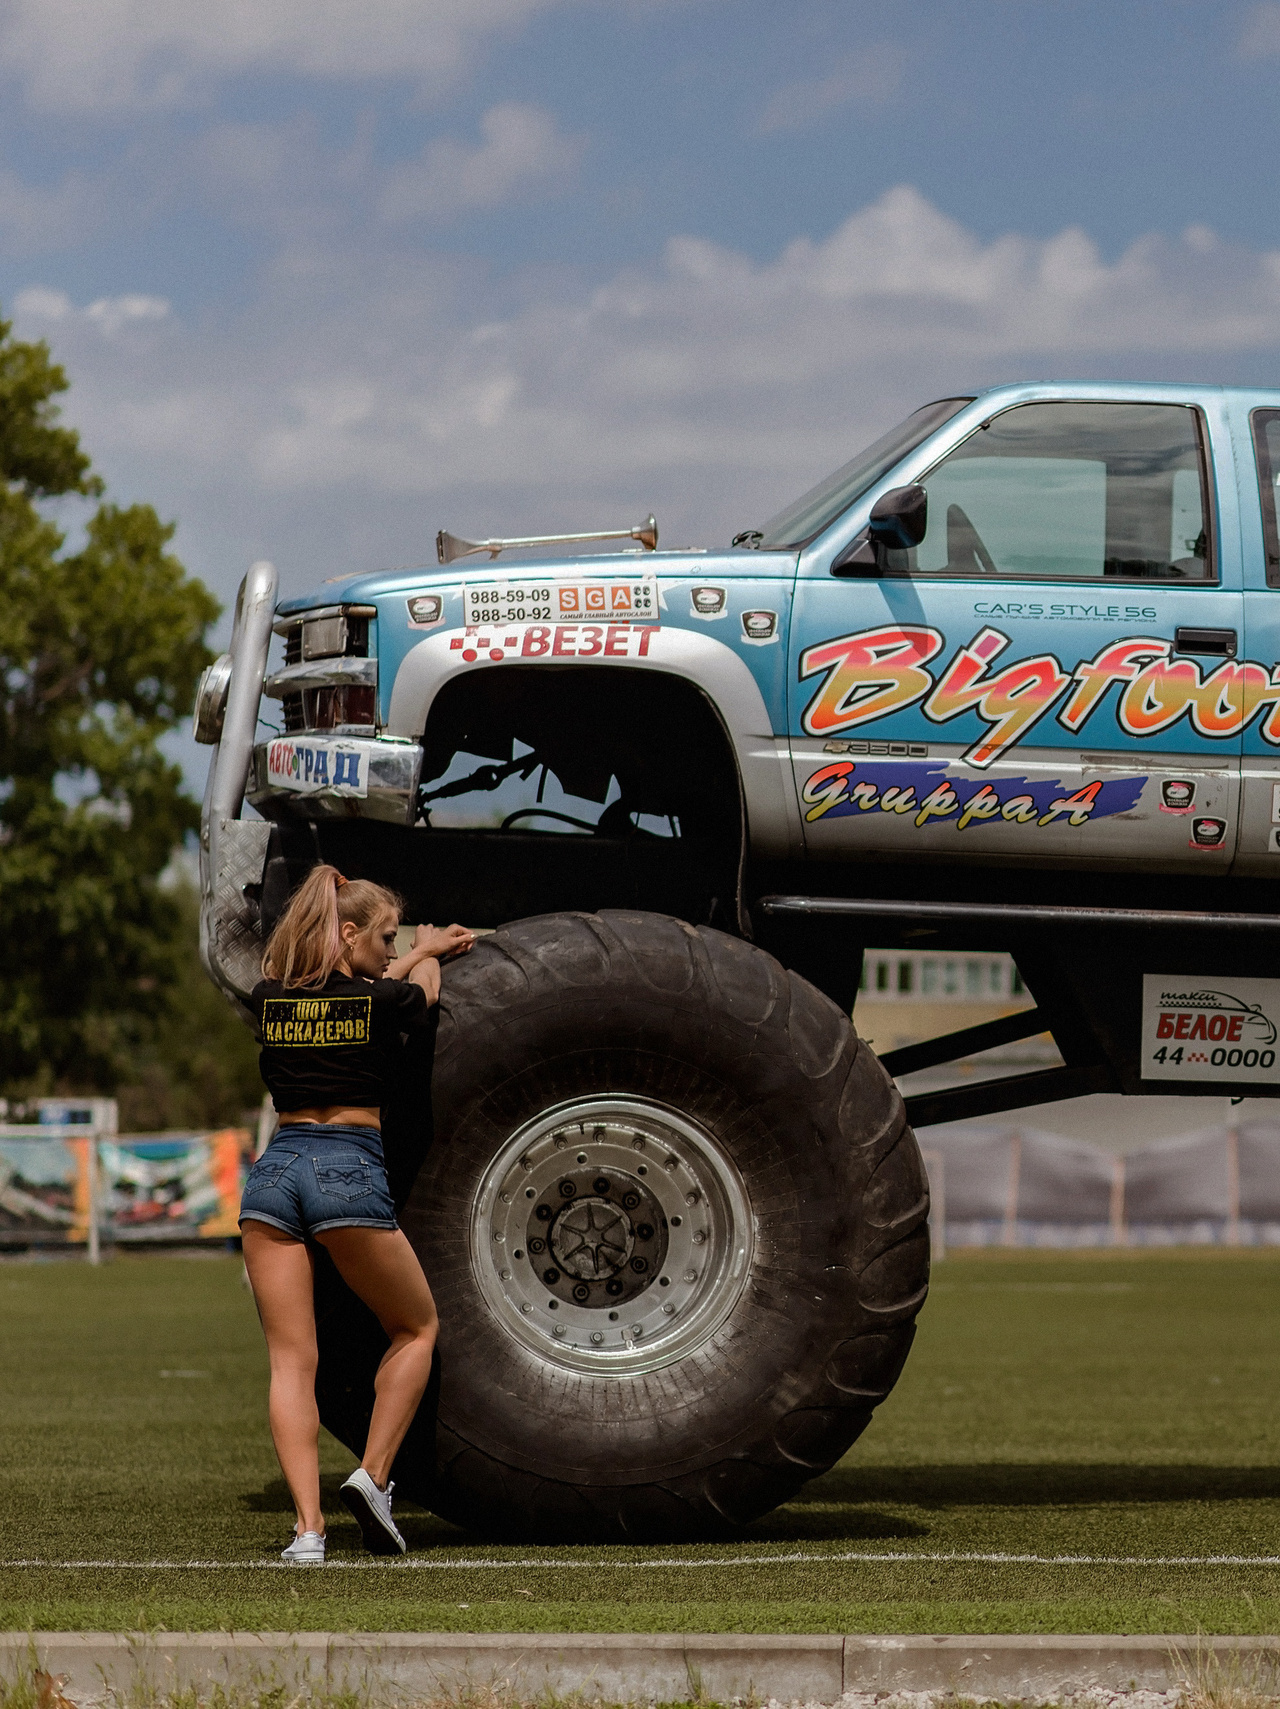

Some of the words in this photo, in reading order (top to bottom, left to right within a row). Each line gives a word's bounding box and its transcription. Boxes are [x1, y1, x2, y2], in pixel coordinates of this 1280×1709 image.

[470, 589, 550, 604] 988-59-09
[560, 588, 630, 610] SGA
[471, 607, 551, 622] 988-50-92
[973, 603, 1044, 614] CAR'S
[1050, 605, 1119, 617] STYLE
[1125, 607, 1157, 618] 56
[849, 741, 928, 757] 3500
[1161, 991, 1218, 1001] такси
[296, 1002, 330, 1020] ШОУ
[266, 1019, 365, 1044] КАСКАДЕРОВ
[1156, 1013, 1245, 1041] БЕЛОЕ
[1153, 1046, 1184, 1065] 44
[1210, 1048, 1276, 1068] 0000
